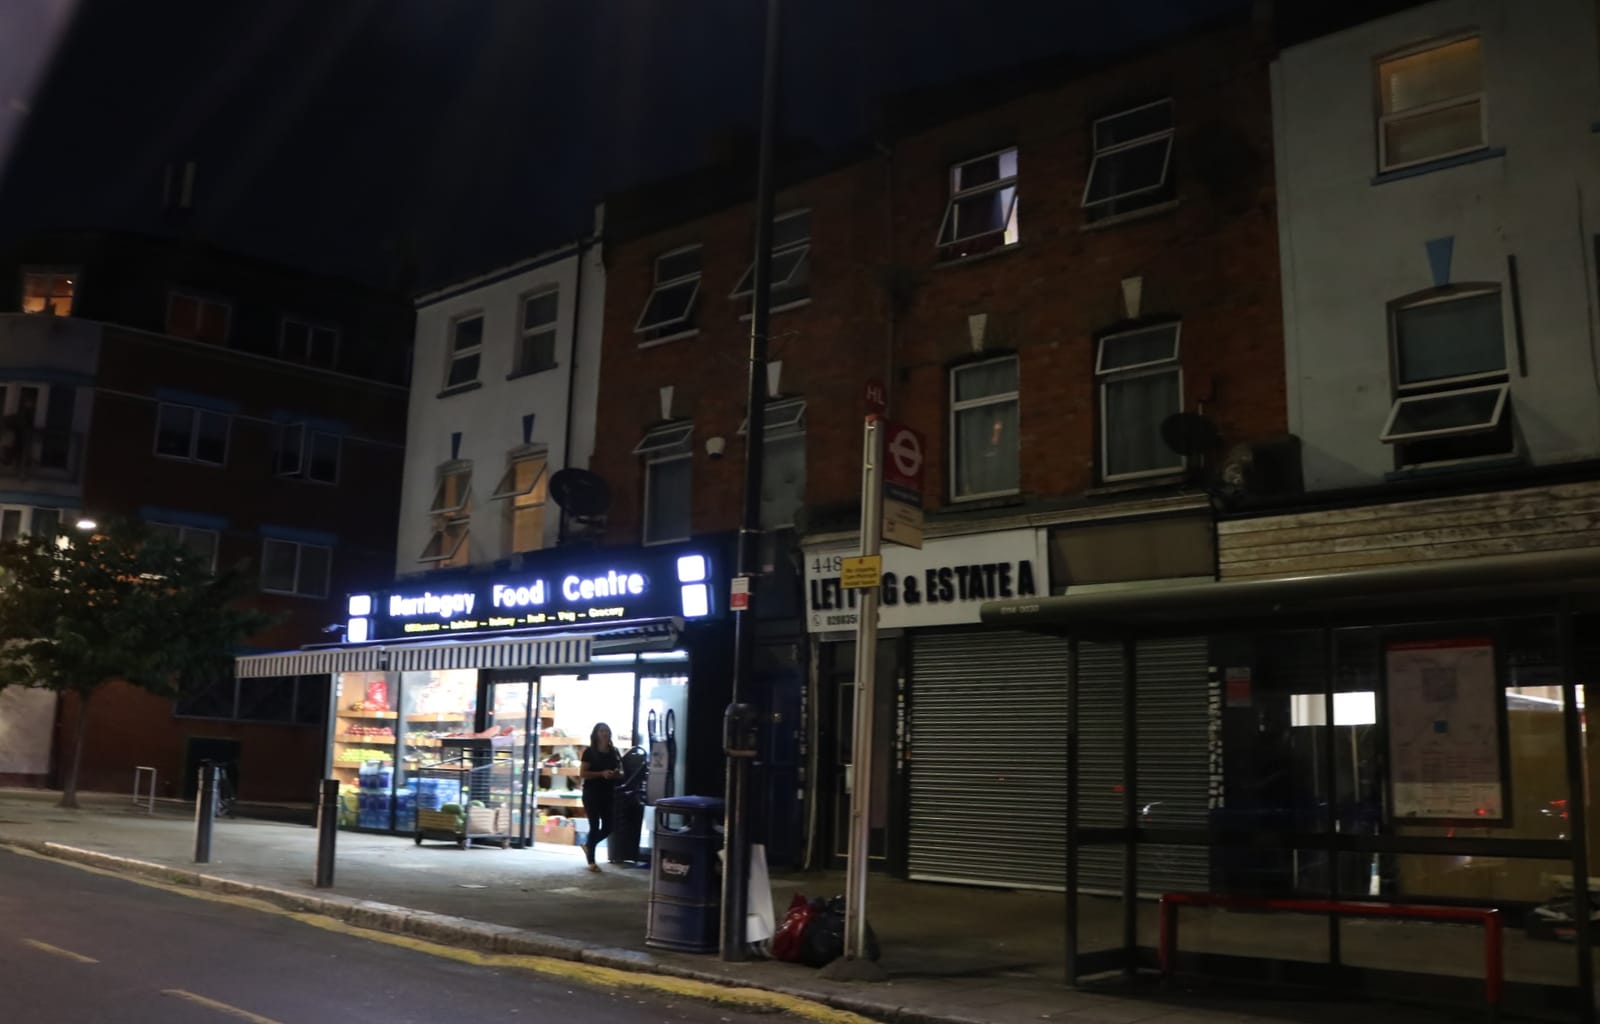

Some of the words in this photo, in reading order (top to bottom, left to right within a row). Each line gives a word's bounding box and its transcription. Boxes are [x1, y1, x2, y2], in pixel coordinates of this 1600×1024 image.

[811, 555, 841, 574] 448
[904, 575, 922, 605] &
[926, 562, 1014, 604] ESTATE
[1018, 560, 1036, 597] A
[493, 580, 545, 607] Food
[563, 570, 645, 601] Centre
